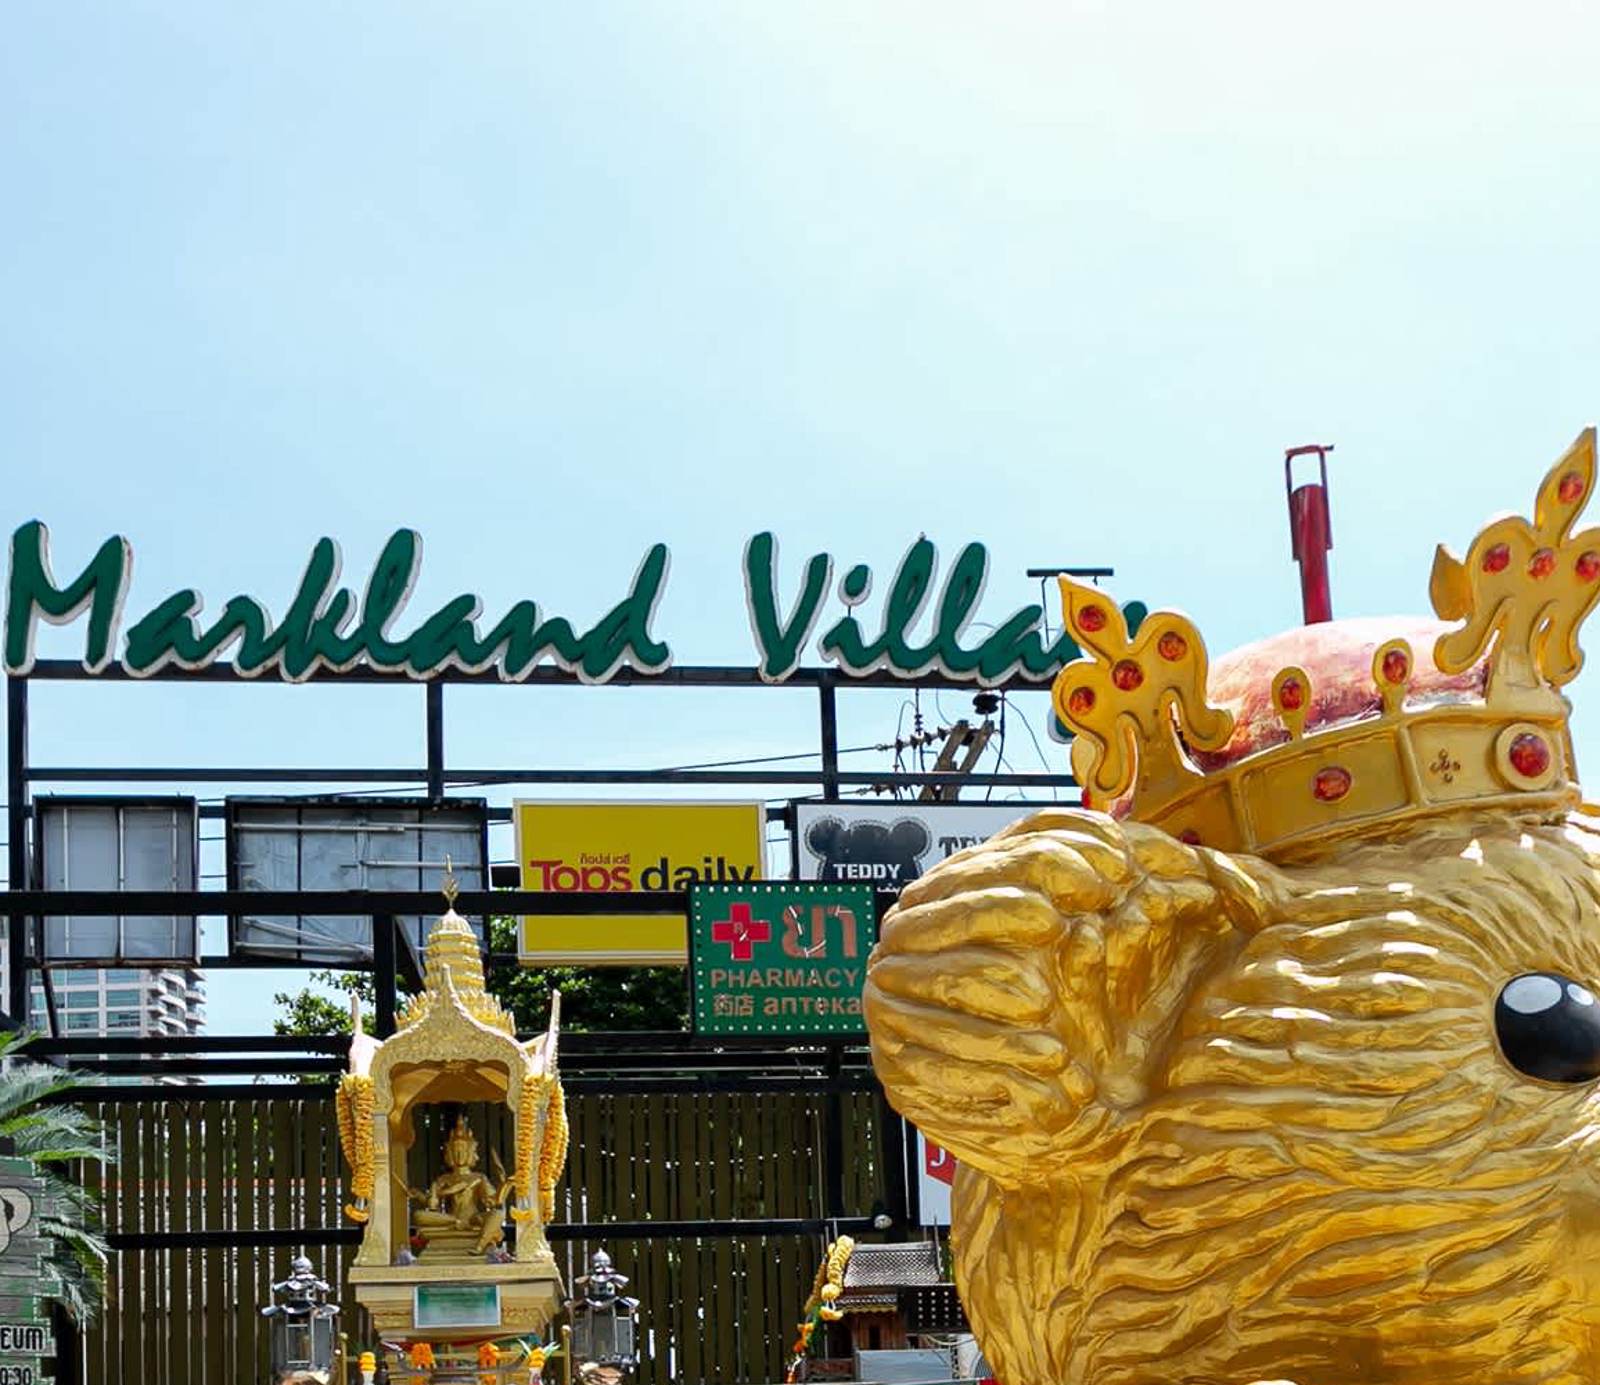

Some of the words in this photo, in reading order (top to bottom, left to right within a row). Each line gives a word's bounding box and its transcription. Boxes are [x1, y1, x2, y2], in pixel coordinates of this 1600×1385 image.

[4, 520, 673, 683] Markland
[529, 859, 634, 892] Tops
[833, 863, 902, 880] TEDDY
[710, 967, 861, 989] PHARMACY
